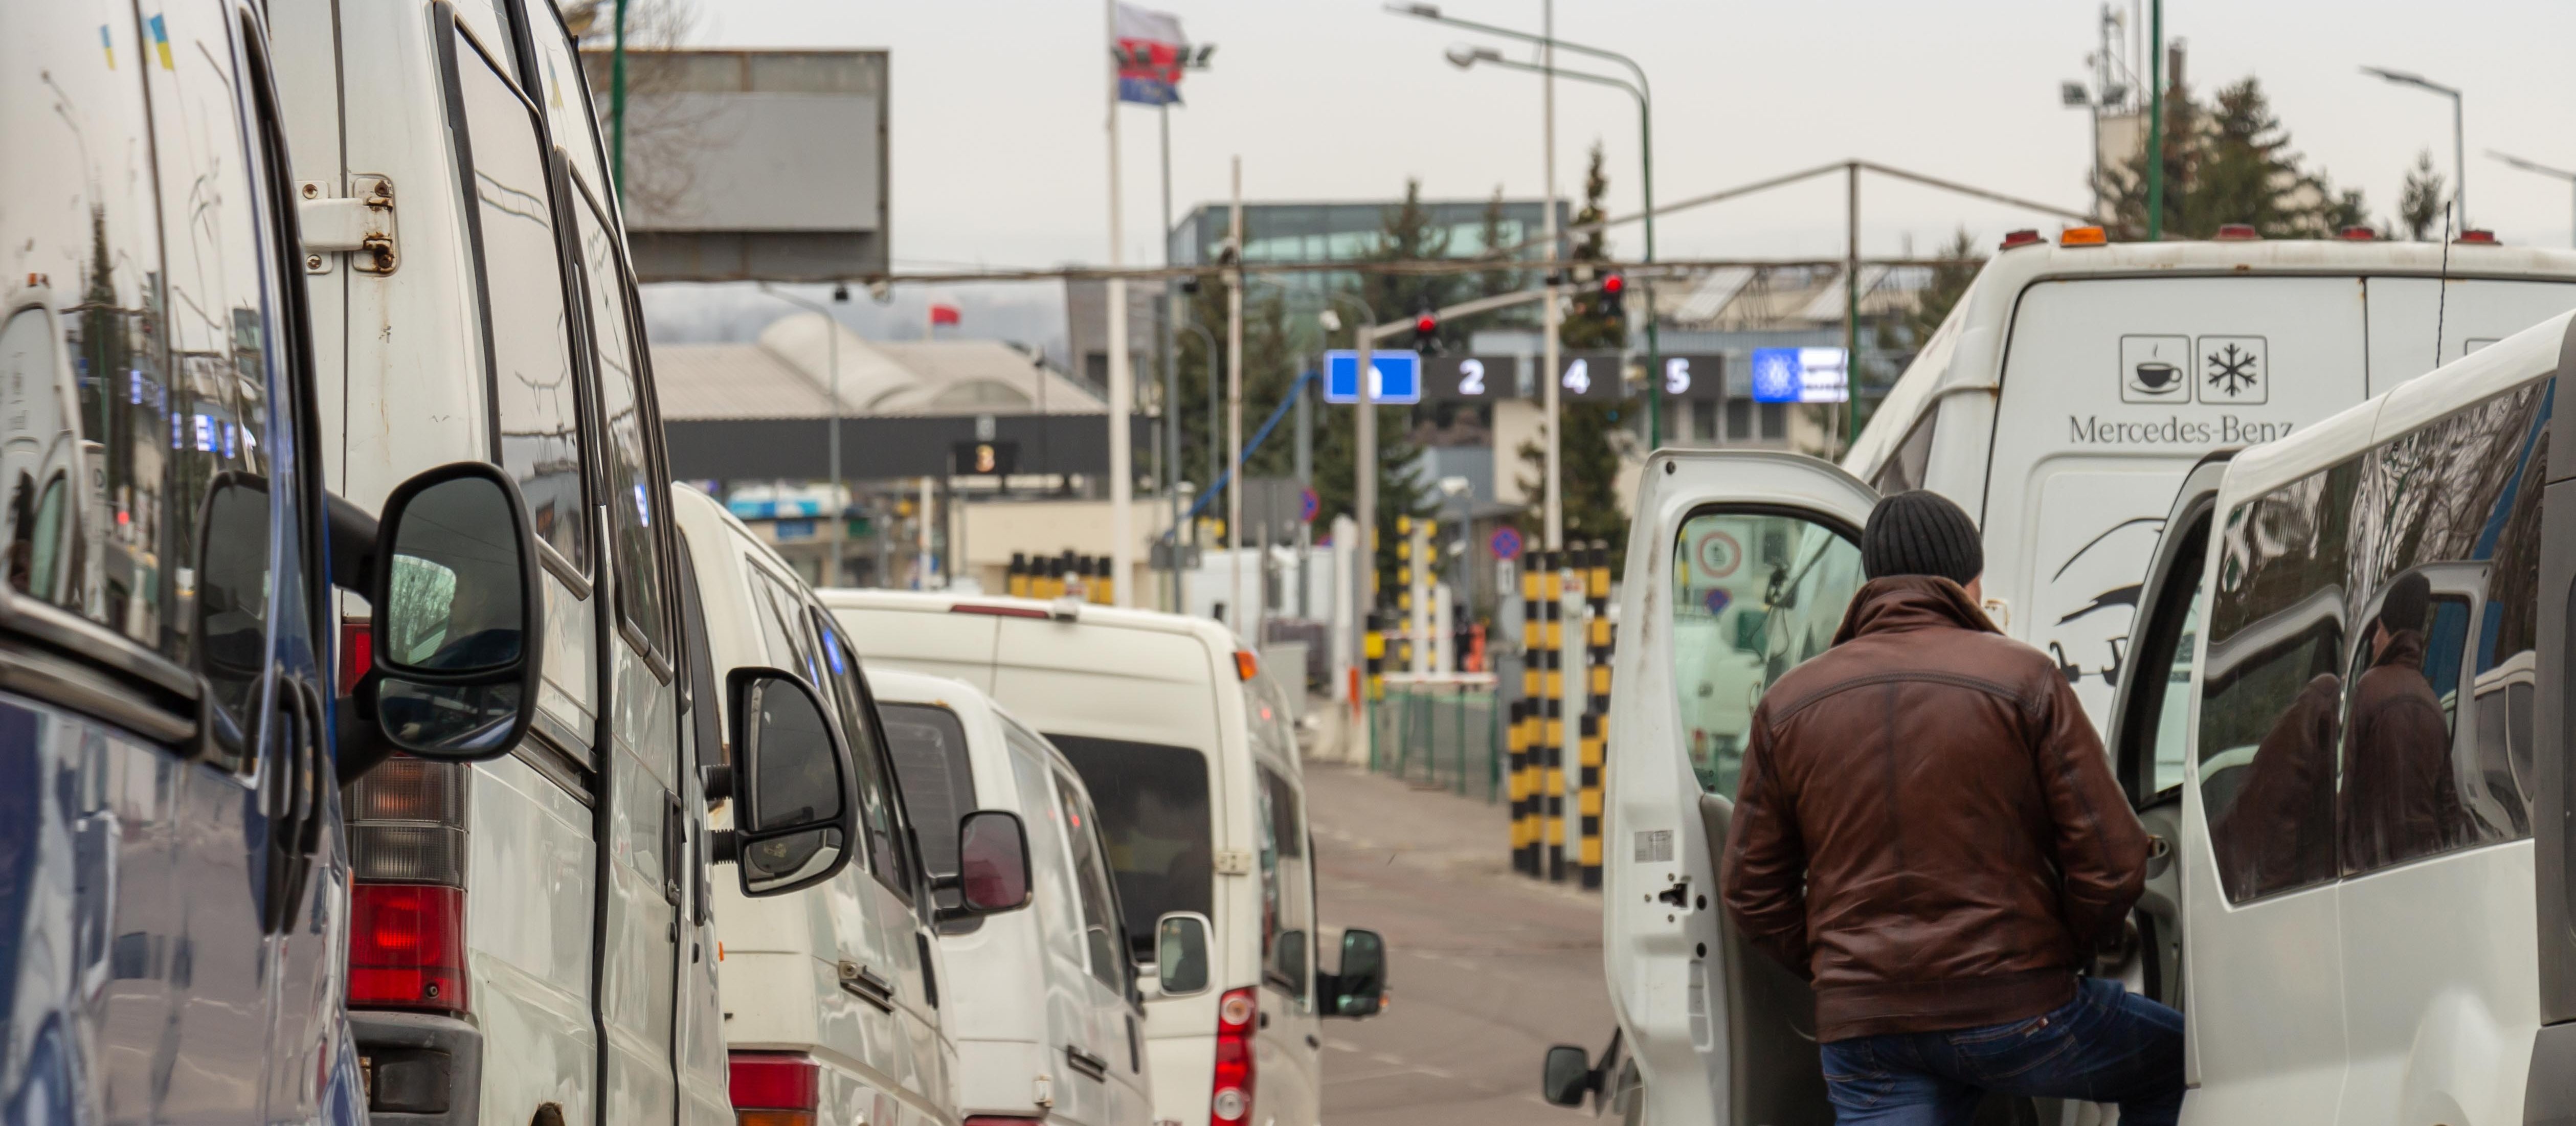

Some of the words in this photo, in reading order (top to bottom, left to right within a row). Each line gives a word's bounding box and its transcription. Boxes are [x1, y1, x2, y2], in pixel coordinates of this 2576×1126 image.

[1459, 359, 1484, 394] 2
[1562, 359, 1590, 394] 4
[1666, 358, 1690, 394] 5
[2070, 415, 2294, 444] Mercedes-Benz
